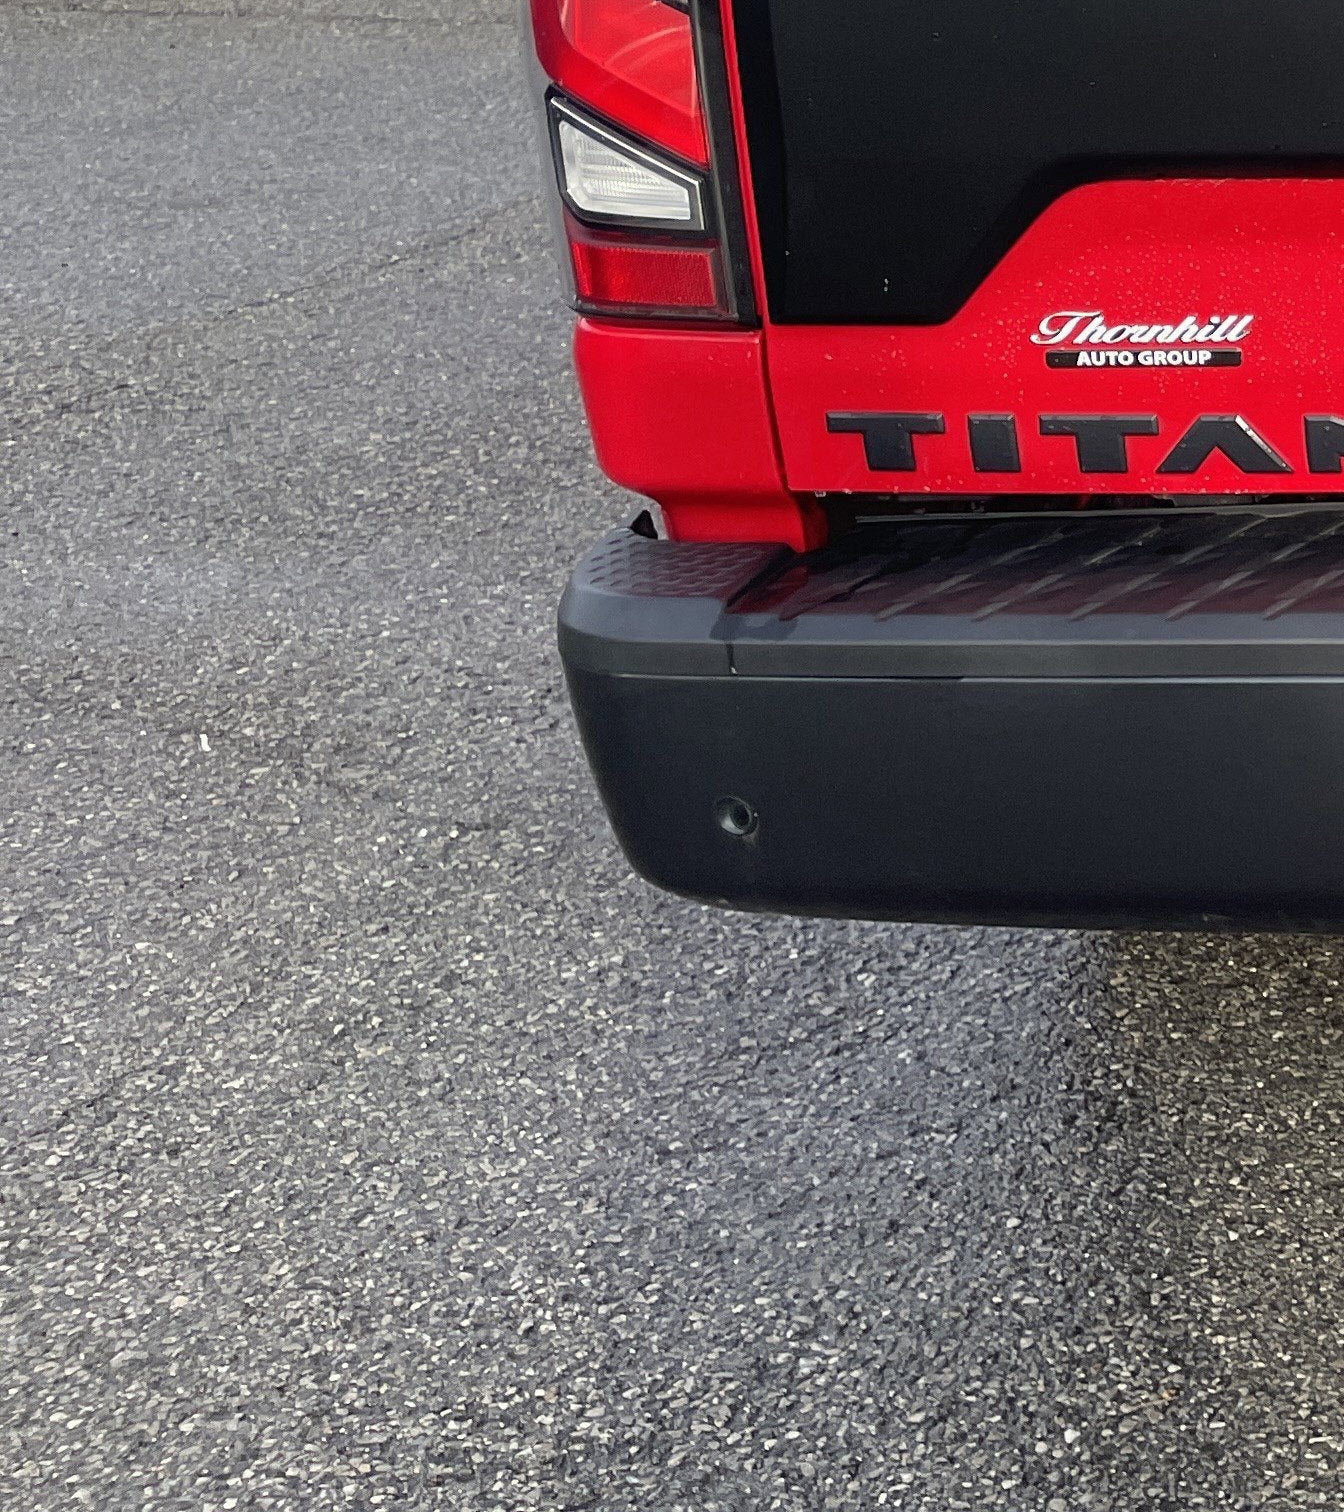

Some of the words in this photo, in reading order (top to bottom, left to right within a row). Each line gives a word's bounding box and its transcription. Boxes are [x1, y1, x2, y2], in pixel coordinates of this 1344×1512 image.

[1029, 310, 1254, 345] Thornhill
[1076, 350, 1134, 366] AUTO
[1138, 350, 1212, 366] GROUP
